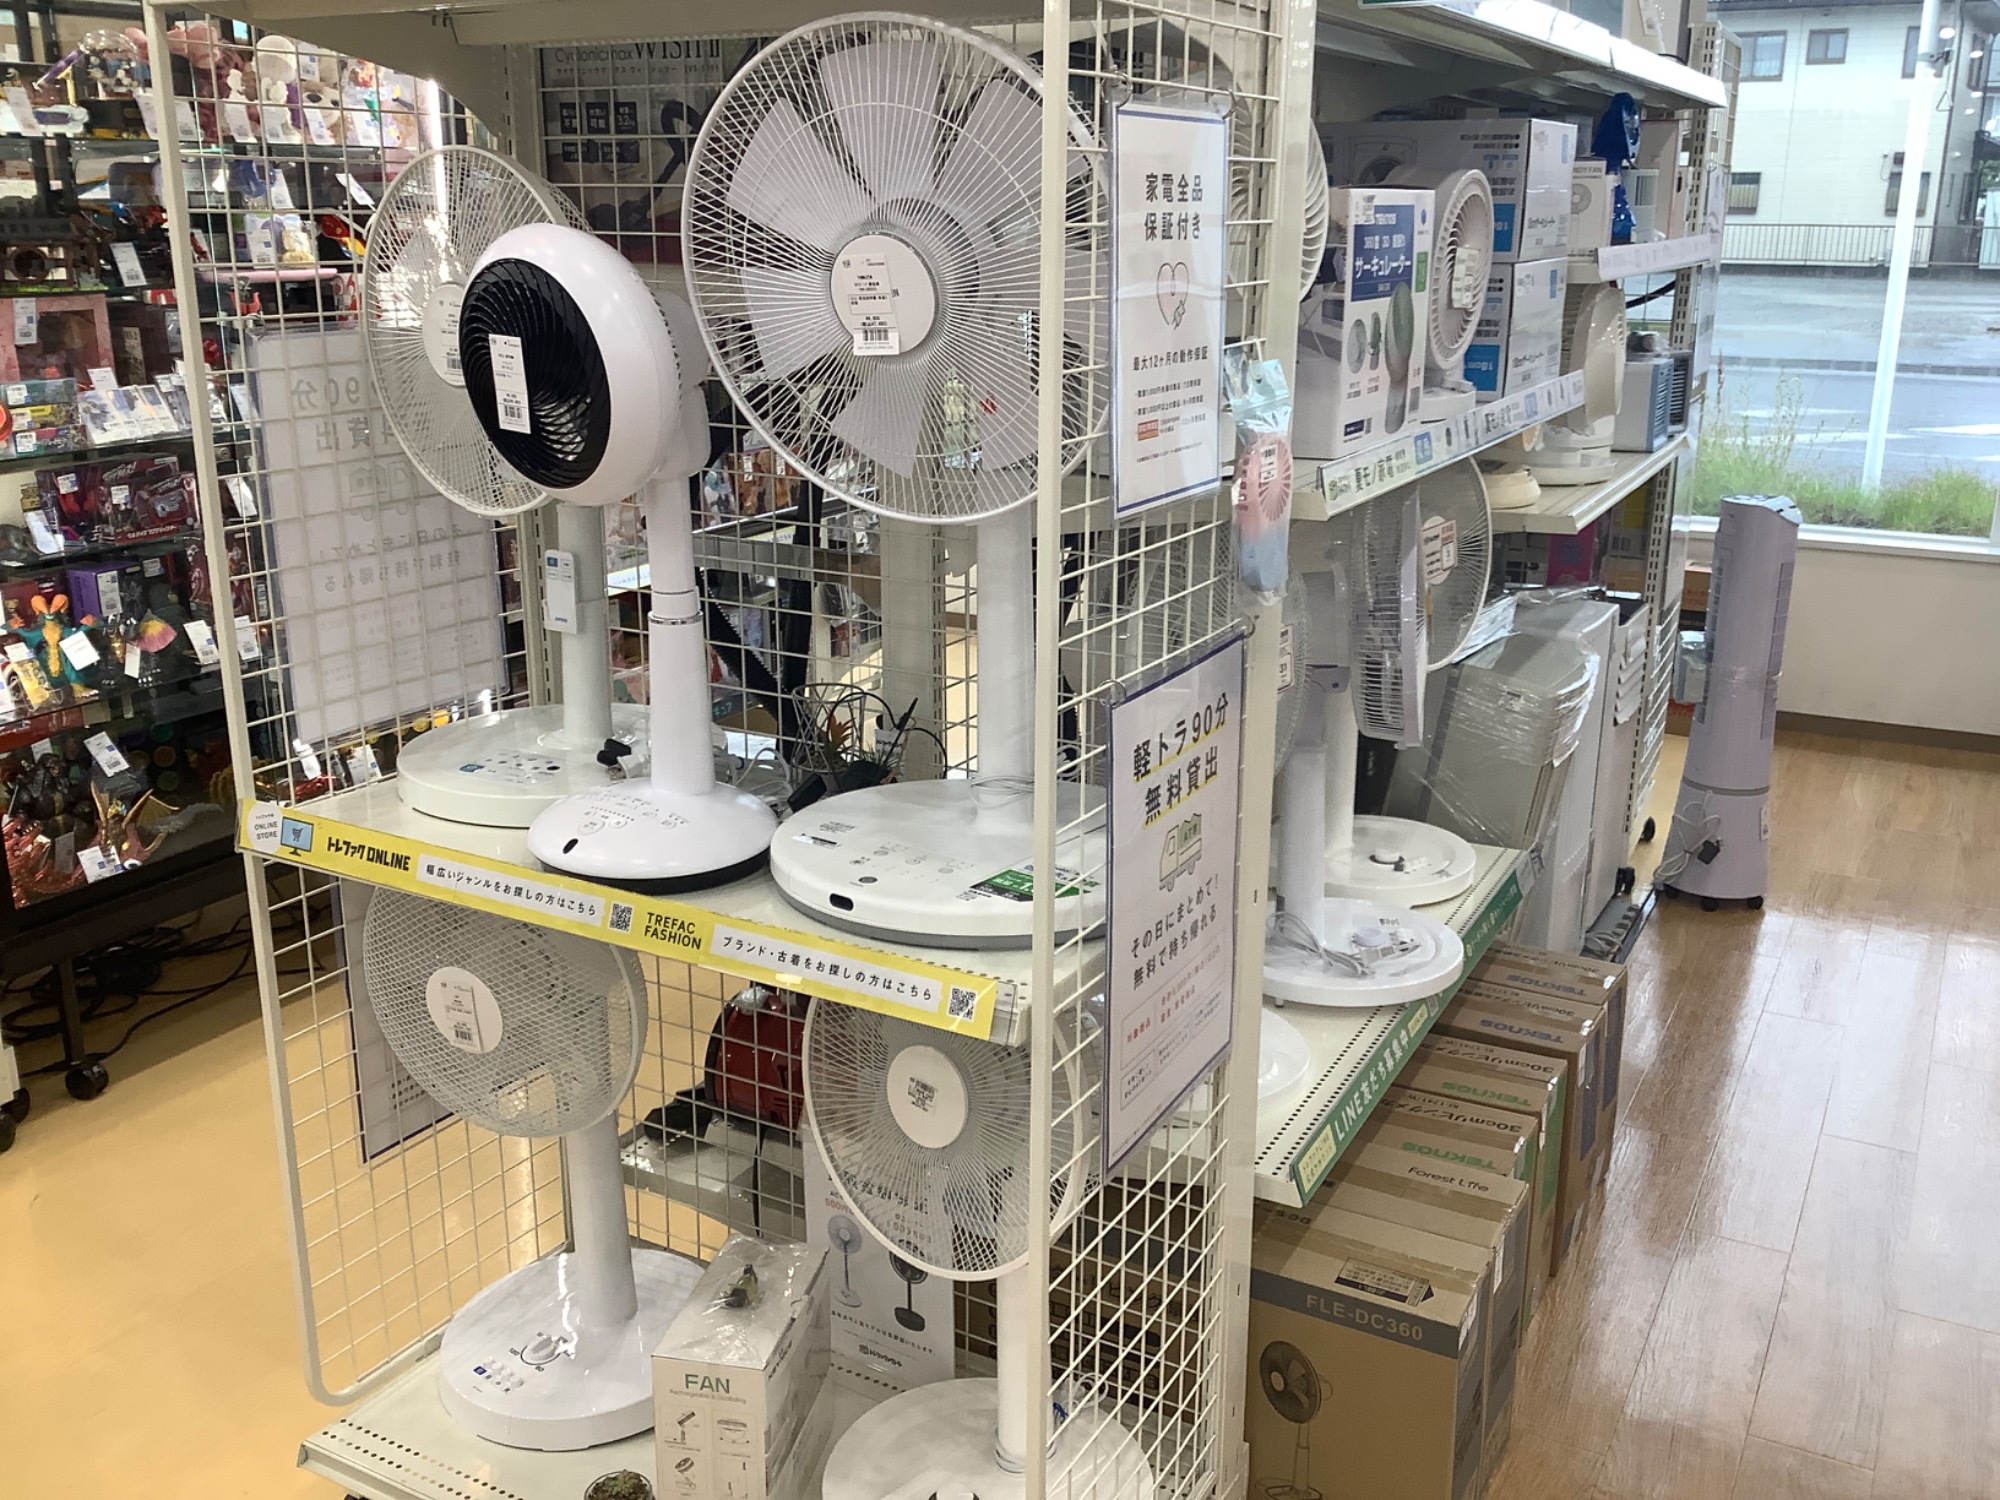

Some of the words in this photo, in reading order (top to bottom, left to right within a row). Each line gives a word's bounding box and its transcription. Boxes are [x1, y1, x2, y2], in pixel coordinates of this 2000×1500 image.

[1145, 173, 1203, 202] 家電全品
[1144, 212, 1201, 240] 保証付き
[1355, 254, 1411, 278] サーキュレーター
[1133, 692, 1229, 782] 軽トラ90分
[1145, 746, 1218, 826] 無料貸出
[254, 821, 278, 831] ONLINE
[256, 830, 278, 840] STORE
[366, 848, 411, 872] ONLINE
[647, 912, 697, 934] TREFAC
[1131, 873, 1219, 959] その日にまとめて!
[644, 924, 702, 951] FASHION
[1133, 903, 1217, 991] 無料で持ち帰れる
[1441, 1081, 1531, 1107] TEKNOS
[1401, 1141, 1496, 1170] TEKNOS
[1408, 1167, 1454, 1184] Forest
[1458, 1177, 1489, 1192] Life
[1305, 1294, 1423, 1341] FLE-DC360
[685, 1374, 730, 1394] FAN
